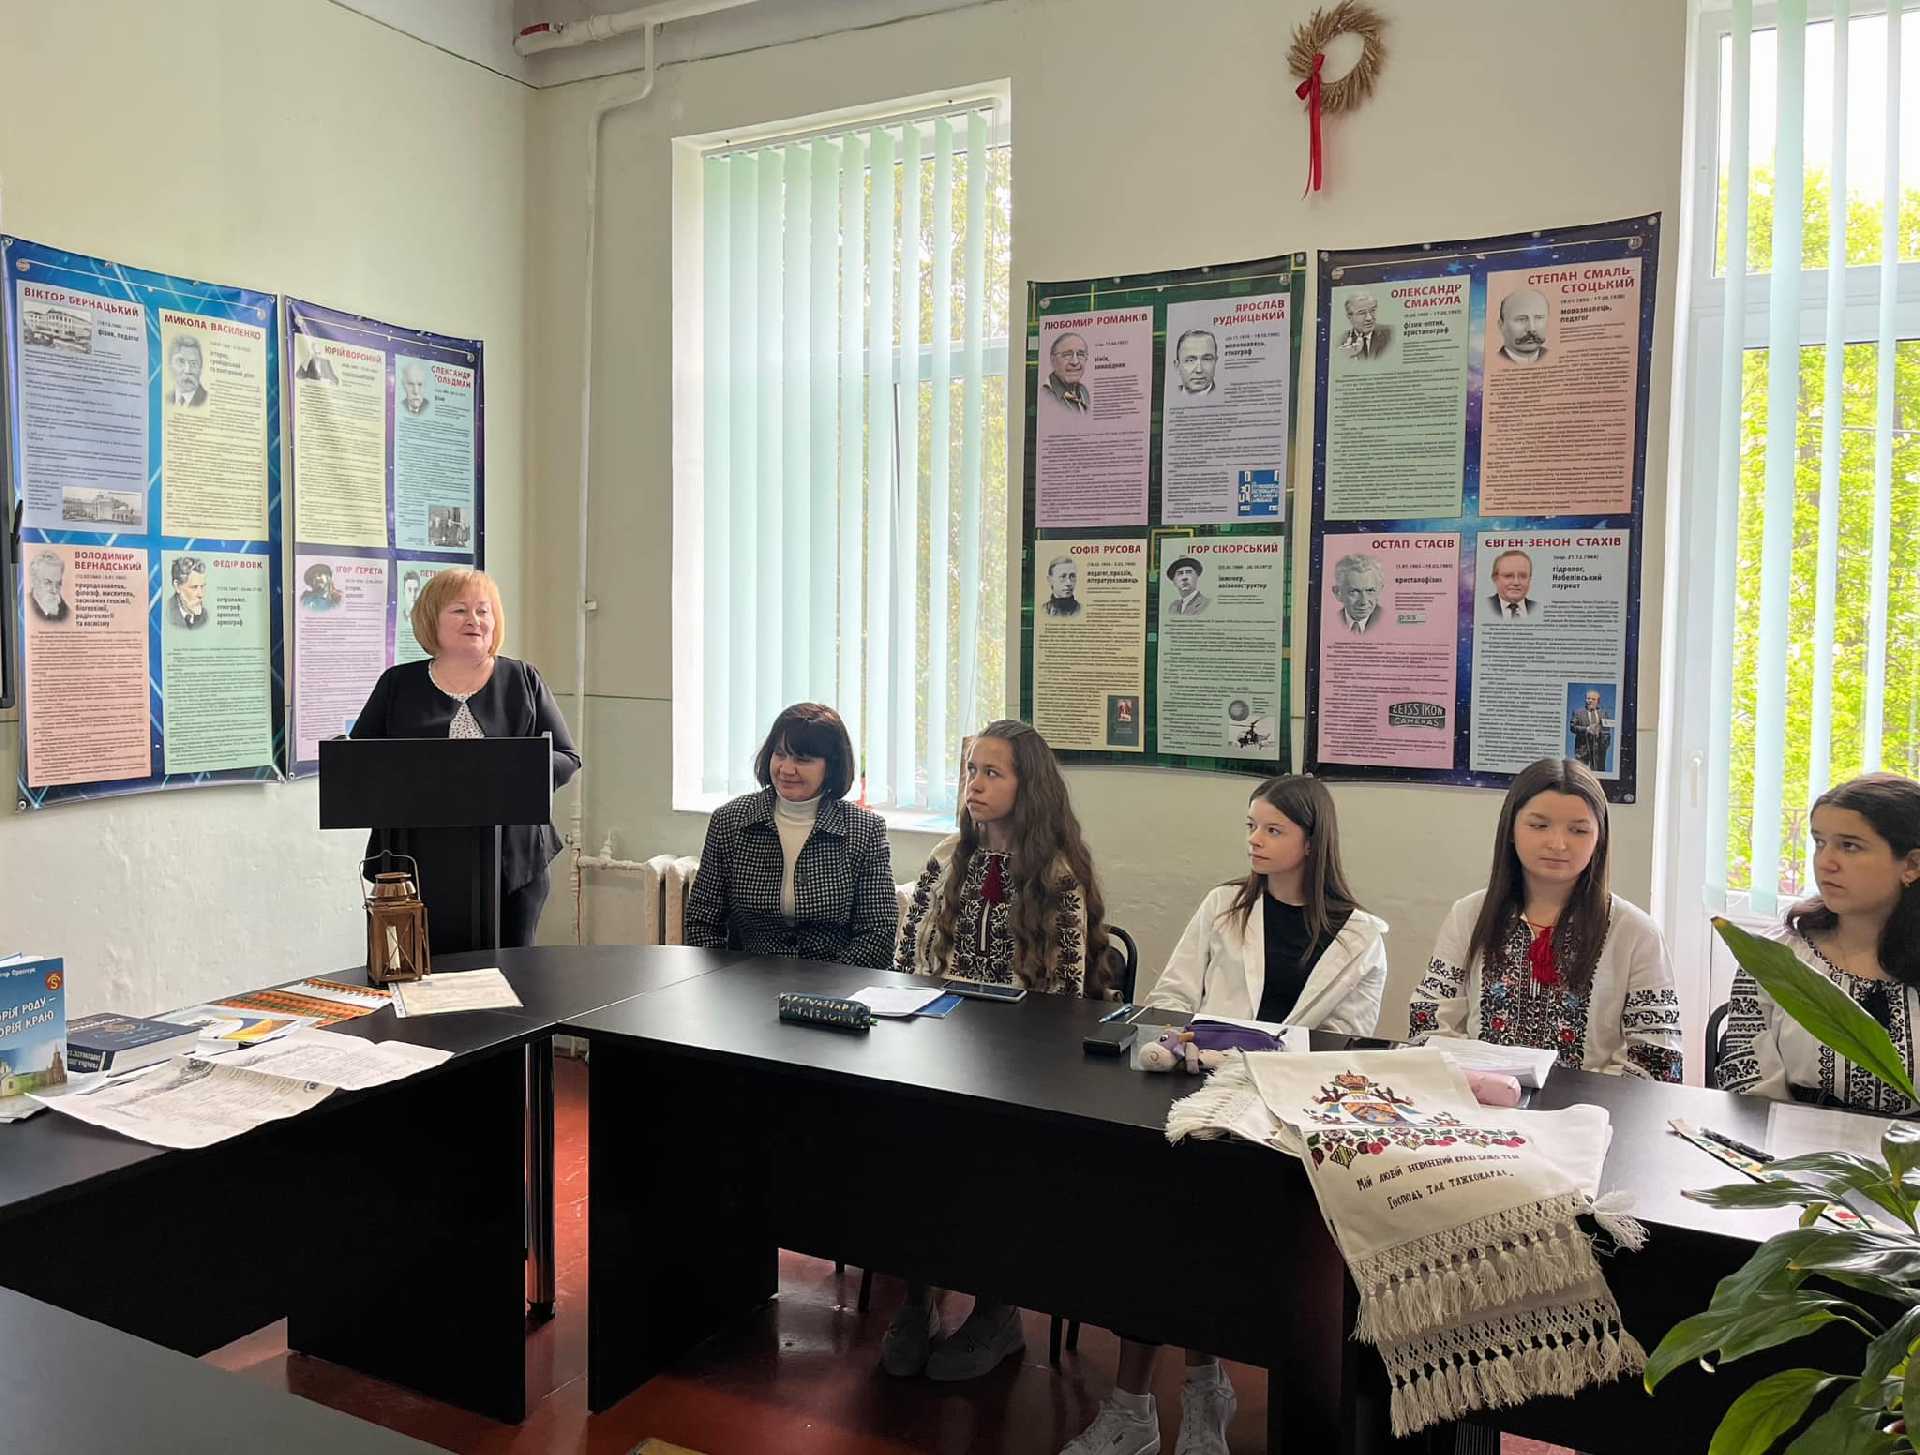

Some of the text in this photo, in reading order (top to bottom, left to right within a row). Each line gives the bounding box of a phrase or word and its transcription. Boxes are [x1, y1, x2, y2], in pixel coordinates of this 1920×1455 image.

[1528, 272, 1577, 285] СТЕПАН
[1391, 284, 1462, 299] ОЛЕКСАНДР
[1561, 277, 1634, 294] СТОЦЬКИЙ
[24, 287, 139, 317] ВІКТОР БЕРНАЦЬКИЙ
[1235, 300, 1285, 313] ЯРОСЛАВ
[1404, 296, 1461, 309] СМАКУЛА
[1044, 318, 1095, 330] ЛЮБОМИР
[1213, 310, 1285, 326] РУДНИЦЬКИЙ
[164, 314, 261, 340] МИКОЛА ВАСИЛЕНКО
[1187, 543, 1278, 554] ІГОР СІКОРСЬКИЙ
[1372, 540, 1455, 549] ОСТАП СТАСІВ
[1485, 537, 1622, 548] ЄВГЕН-ЗЕНОН СТАХІВ
[74, 551, 135, 561] ВОЛОДИМИР
[1070, 545, 1142, 555] СОФІЯ РУСОВА
[74, 561, 142, 571] ВЕРНАДСЬКИЙ
[213, 560, 263, 569] ФЕДІР ВОВК
[1392, 703, 1443, 716] ZEISS IKON
[22, 996, 46, 1014] РОДУ
[25, 1011, 54, 1029] КРАЮ
